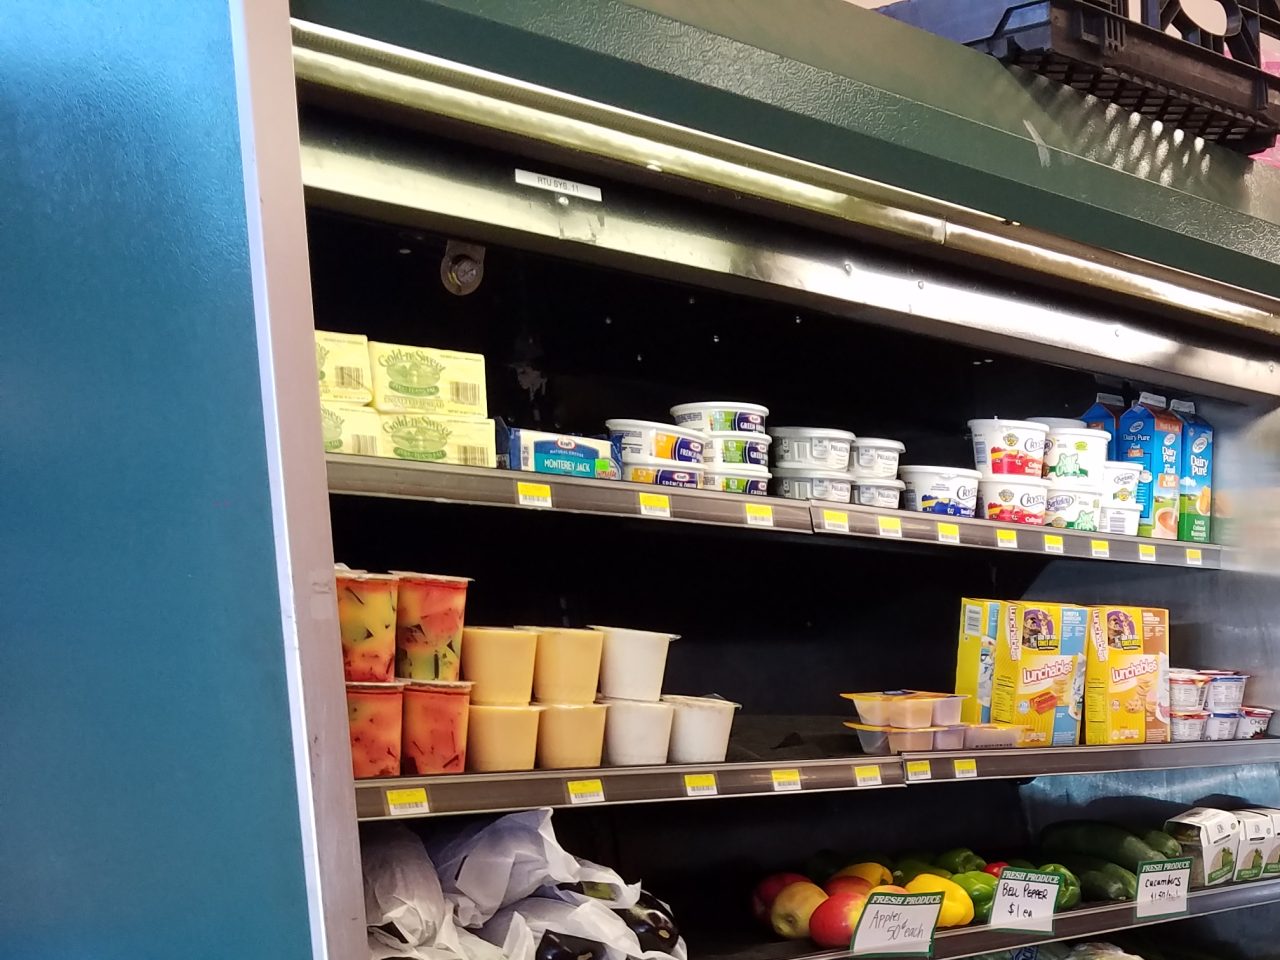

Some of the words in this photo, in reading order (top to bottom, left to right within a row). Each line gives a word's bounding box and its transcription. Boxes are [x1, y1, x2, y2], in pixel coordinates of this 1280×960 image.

[544, 459, 576, 471] MONTEREY
[576, 463, 591, 472] JACK
[1190, 456, 1209, 468] Dairy
[1023, 660, 1073, 685] Lunchables
[1112, 658, 1158, 683] Lunchables
[1141, 863, 1163, 873] FRESH
[1163, 860, 1191, 871] PRODUCE
[1001, 870, 1026, 880] FRESH
[1026, 873, 1061, 884] PRODUCE
[1023, 883, 1048, 900] PEPPER
[870, 895, 903, 904] FRESH
[903, 894, 942, 905] PRODUCE
[903, 923, 924, 939] each
